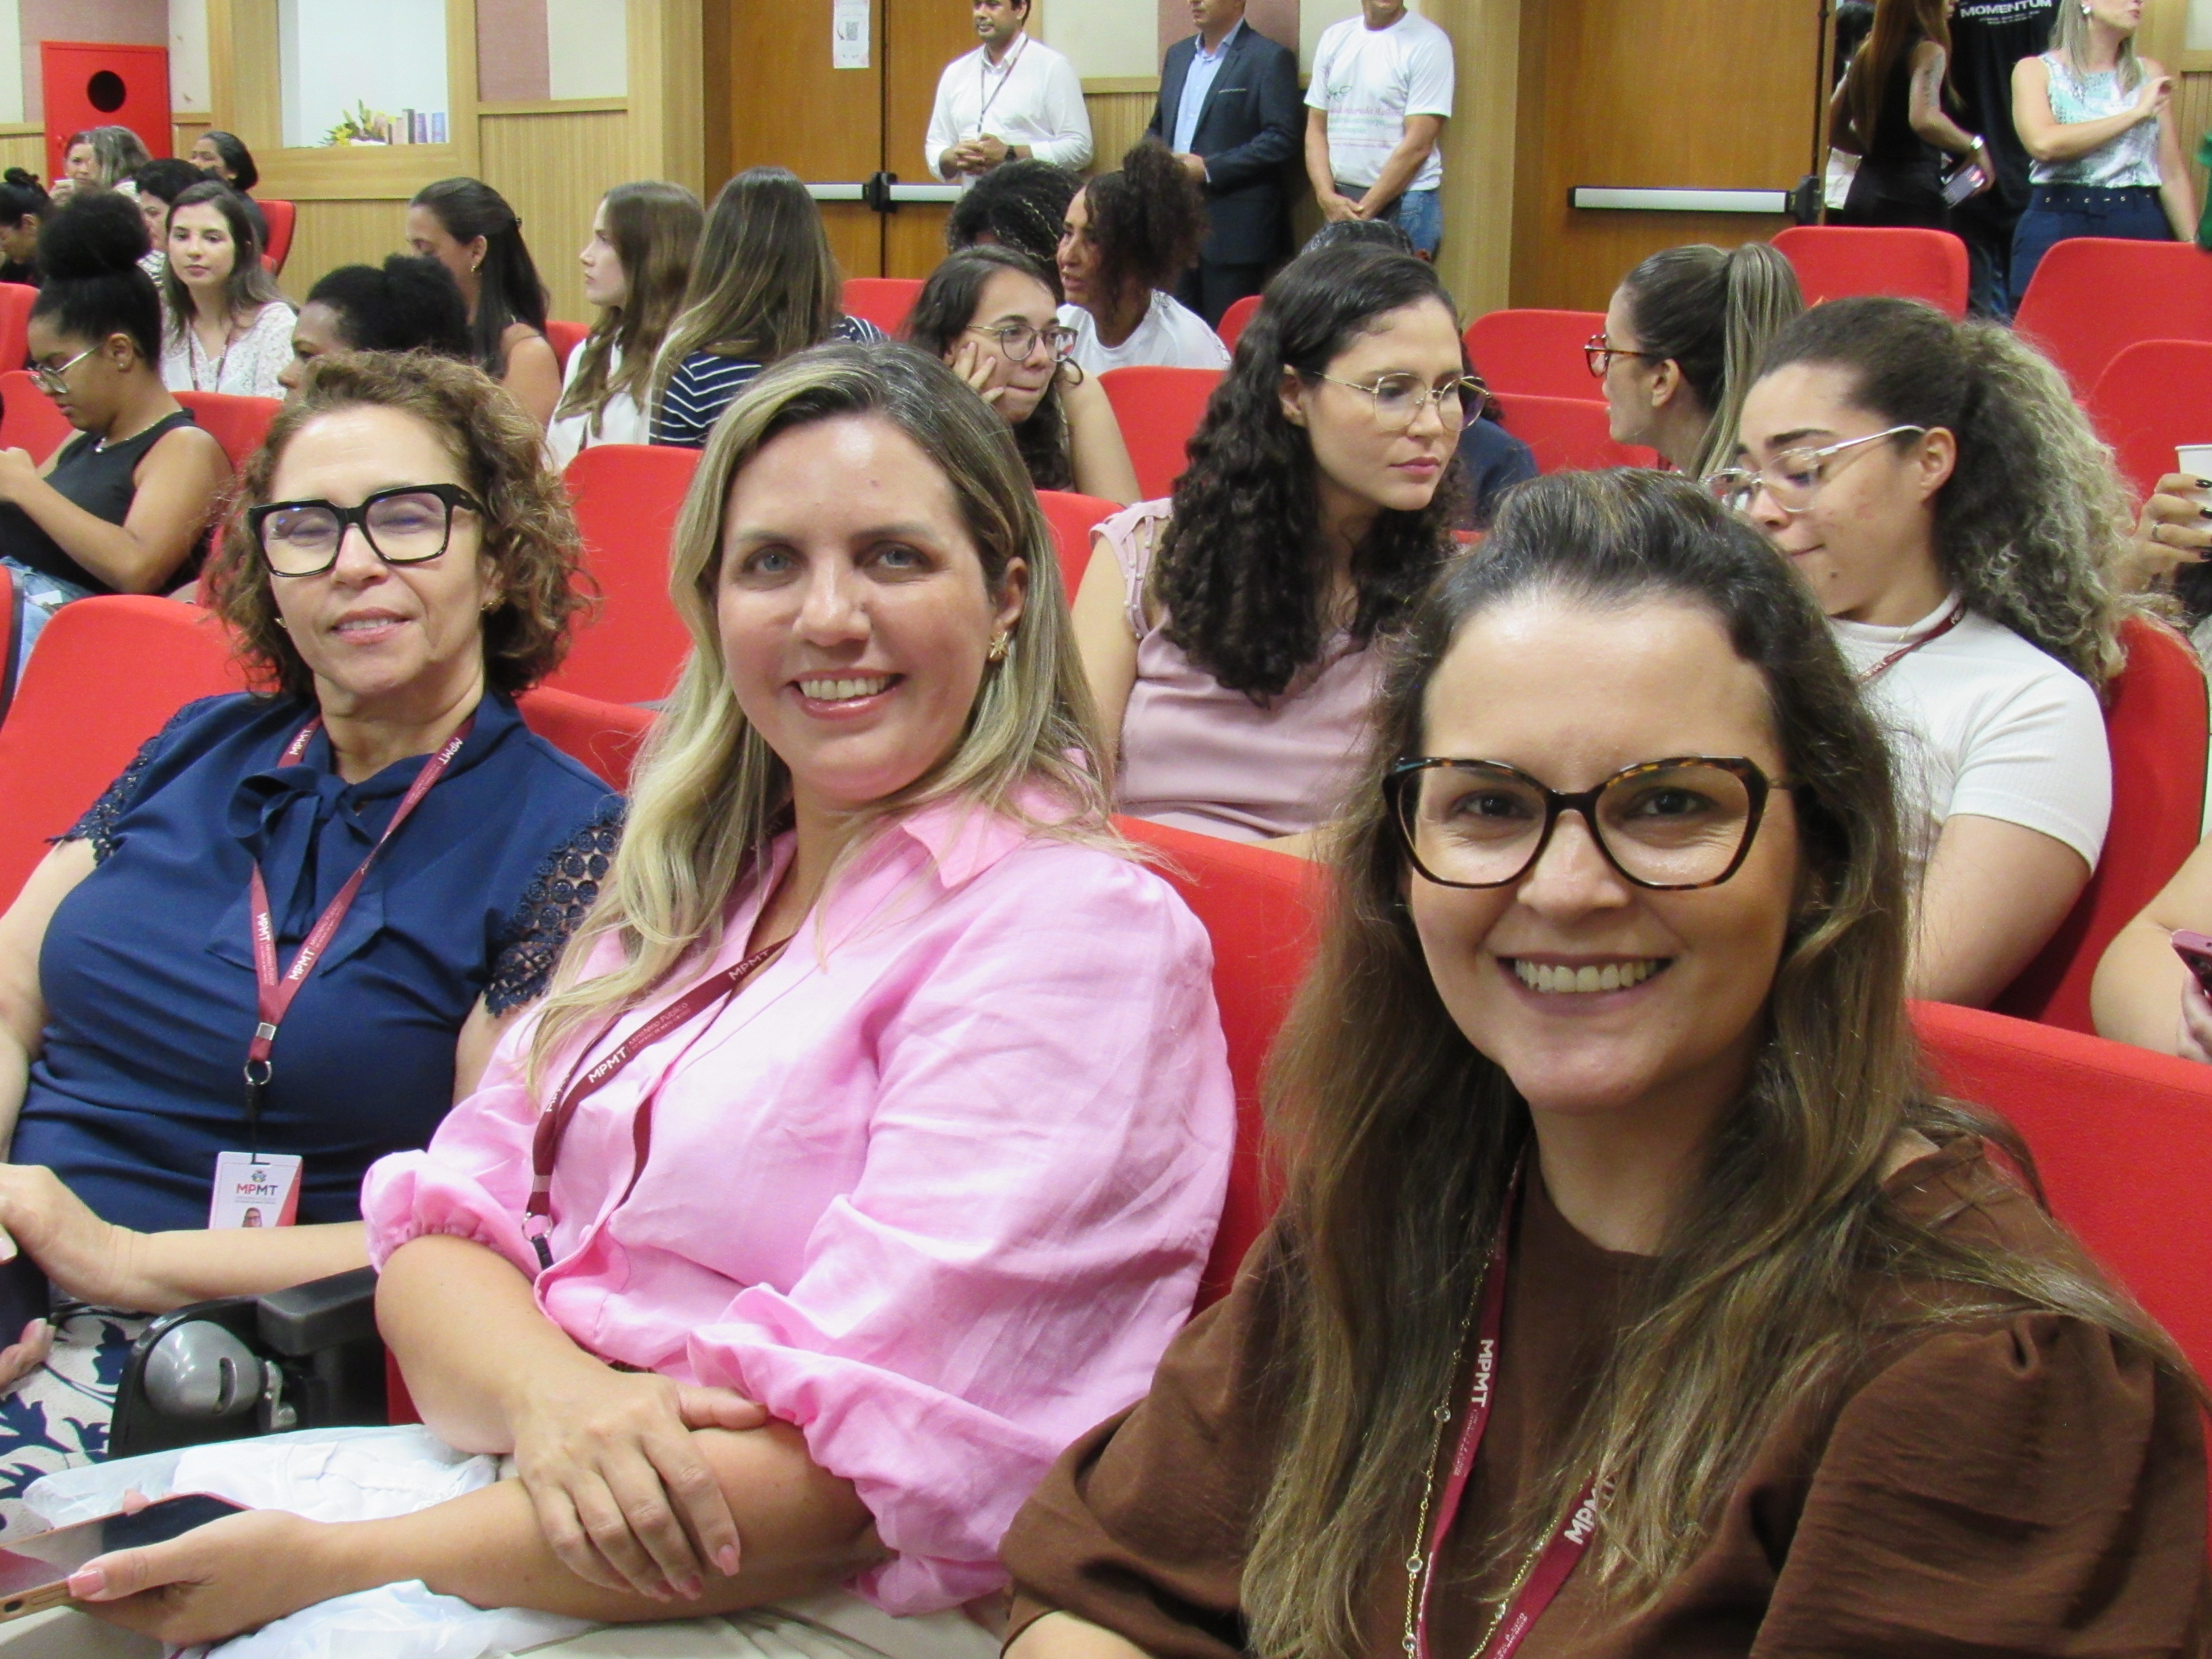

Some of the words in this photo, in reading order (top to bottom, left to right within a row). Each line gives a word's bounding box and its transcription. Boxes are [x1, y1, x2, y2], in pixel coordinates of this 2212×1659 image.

[1960, 0, 2052, 18] MOMENTUM
[438, 737, 463, 764] MPMT
[258, 913, 270, 941] MPMT
[288, 947, 315, 980] MPMT
[729, 949, 769, 981] MPMT
[588, 1046, 626, 1084] MPMT
[236, 1183, 279, 1195] MPMT
[1471, 1339, 1494, 1408] MPMT
